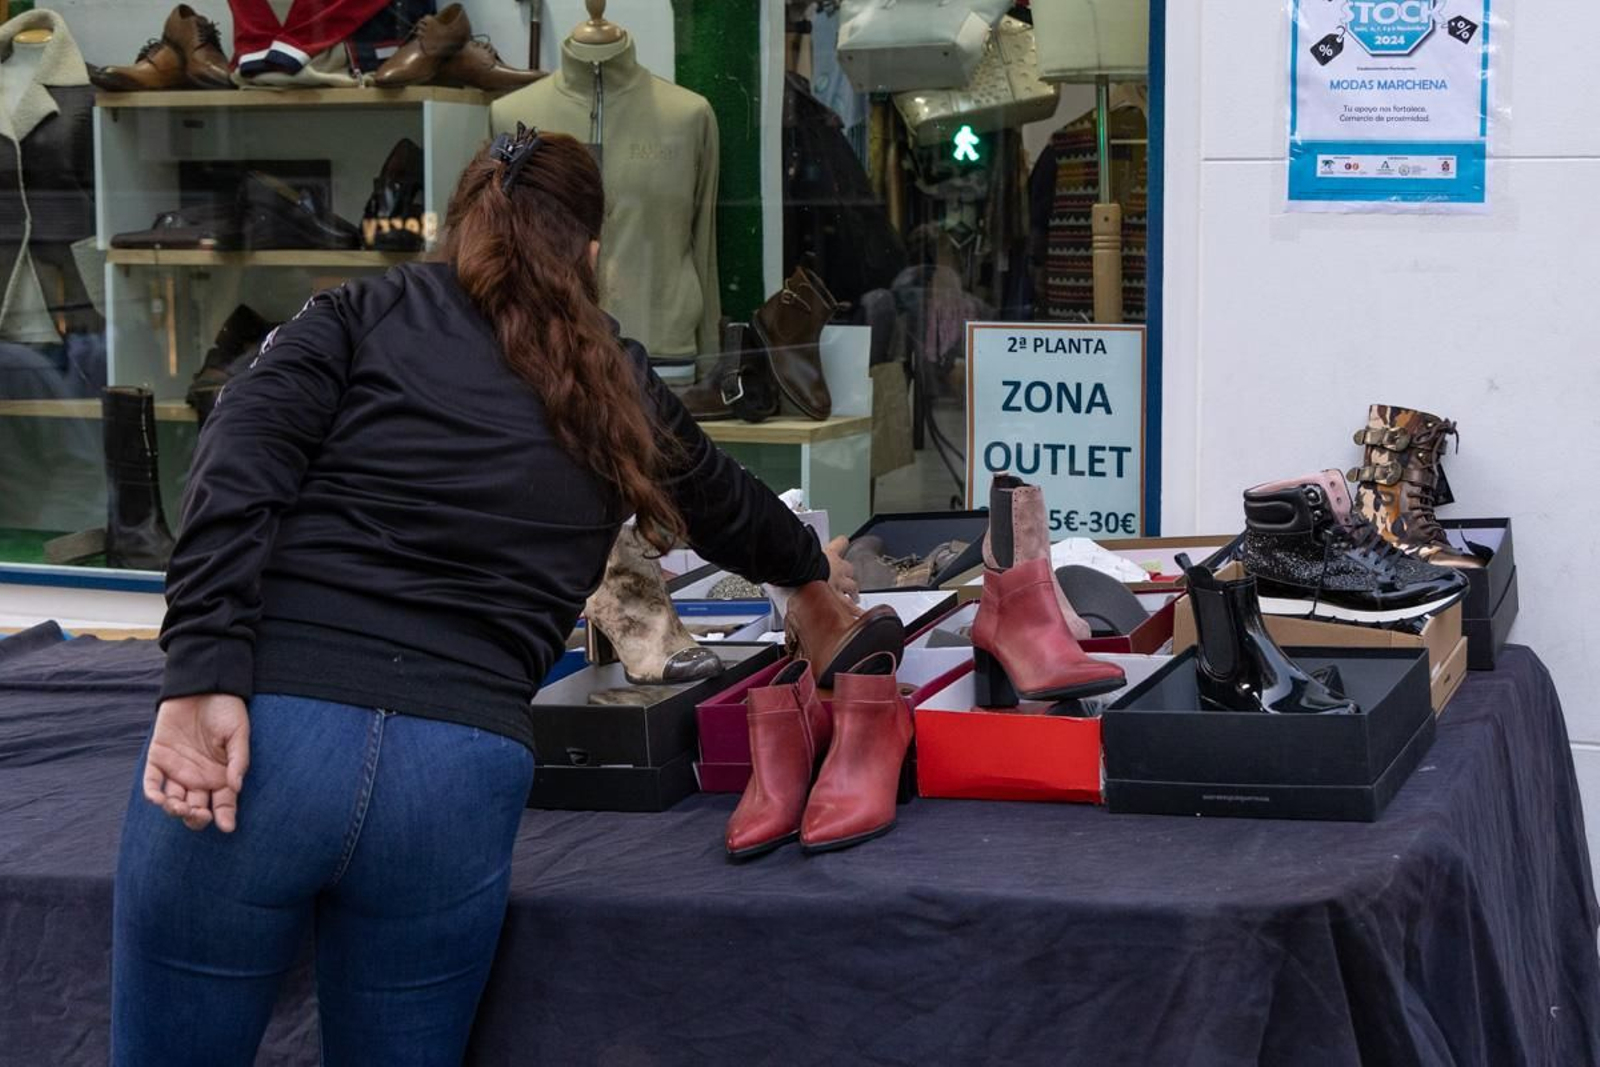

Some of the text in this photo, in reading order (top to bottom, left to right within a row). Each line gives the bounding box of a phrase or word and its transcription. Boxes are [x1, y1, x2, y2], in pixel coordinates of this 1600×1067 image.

[1341, 1, 1443, 25] STOCK
[1375, 35, 1405, 45] 2024
[1329, 79, 1448, 90] MODAS MARCHENA
[1339, 114, 1374, 122] Comercio
[1375, 114, 1384, 122] de
[1007, 336, 1108, 355] 2ª PLANTA
[1001, 380, 1113, 415] ZONA
[983, 441, 1132, 478] OUTLET
